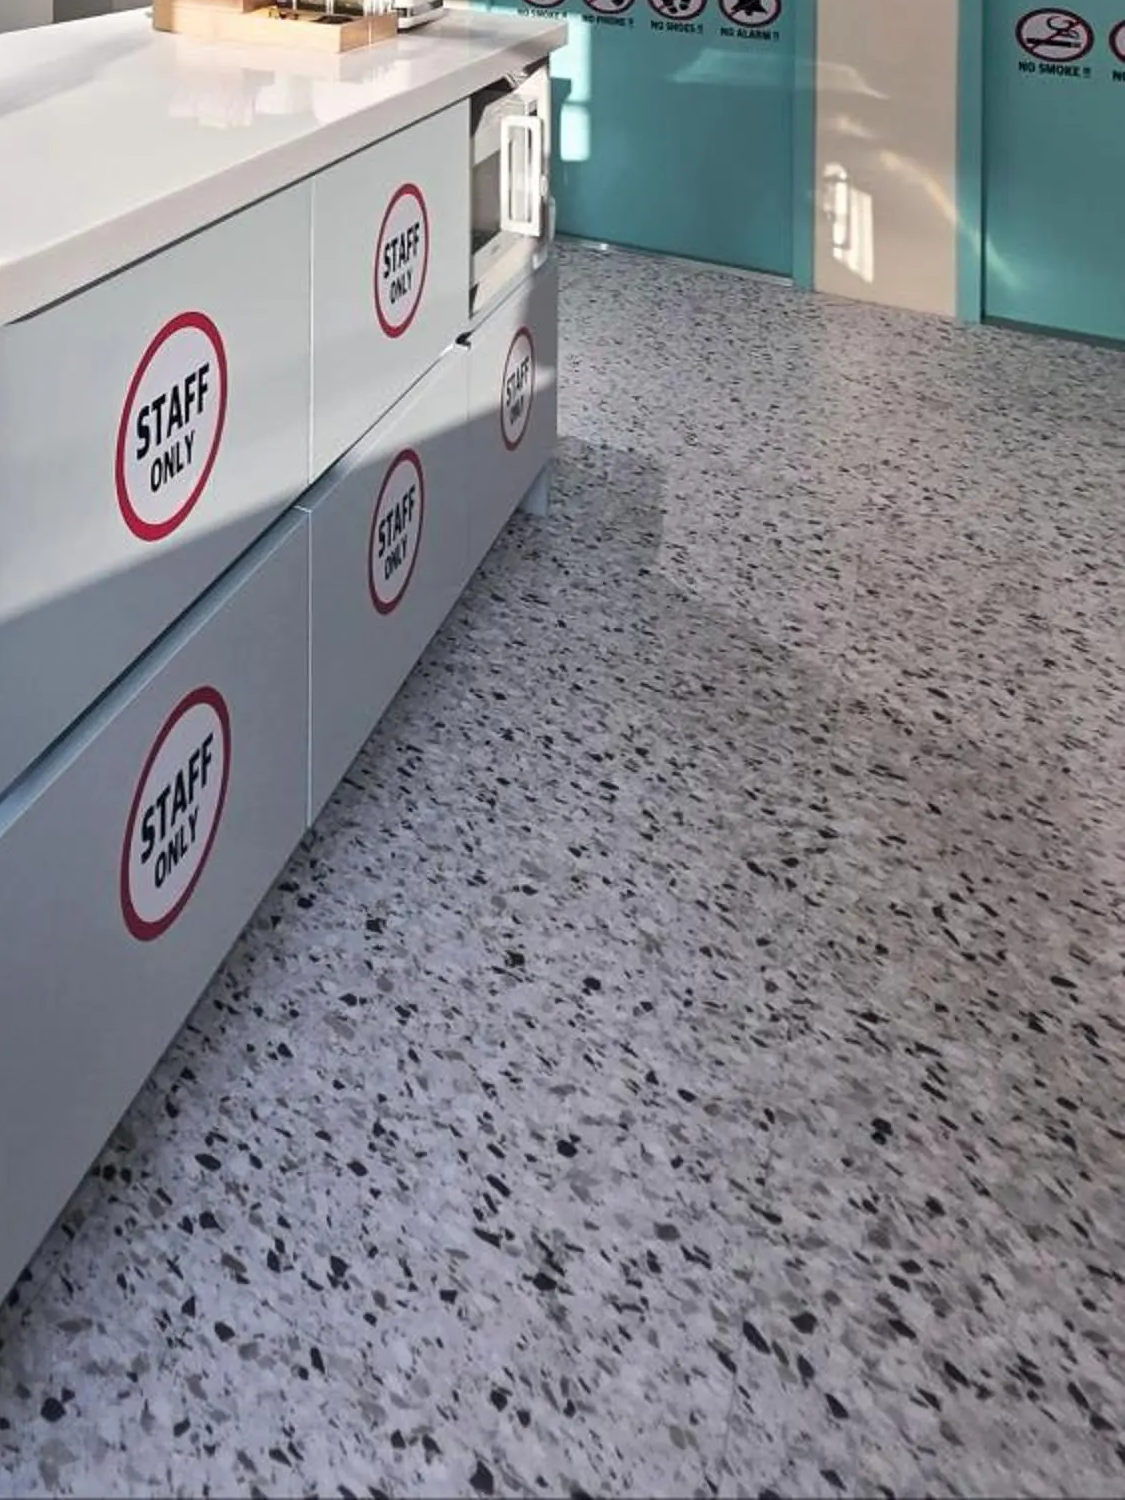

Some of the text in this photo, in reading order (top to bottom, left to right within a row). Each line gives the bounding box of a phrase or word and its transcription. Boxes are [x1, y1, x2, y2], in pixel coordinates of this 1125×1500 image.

[650, 20, 664, 31] NO
[720, 27, 734, 37] NO
[737, 28, 771, 41] ALARM
[1019, 61, 1036, 73] NO
[1038, 63, 1081, 77] SMOKE
[383, 221, 420, 280] STAFF
[390, 267, 413, 304] ONLY
[505, 356, 530, 408] STAFF
[135, 362, 210, 461] STAFF
[150, 431, 196, 493] ONLY
[378, 483, 416, 559] STAFF
[384, 537, 408, 582] ONLY
[140, 730, 214, 866] STAFF
[155, 807, 199, 889] ONLY
